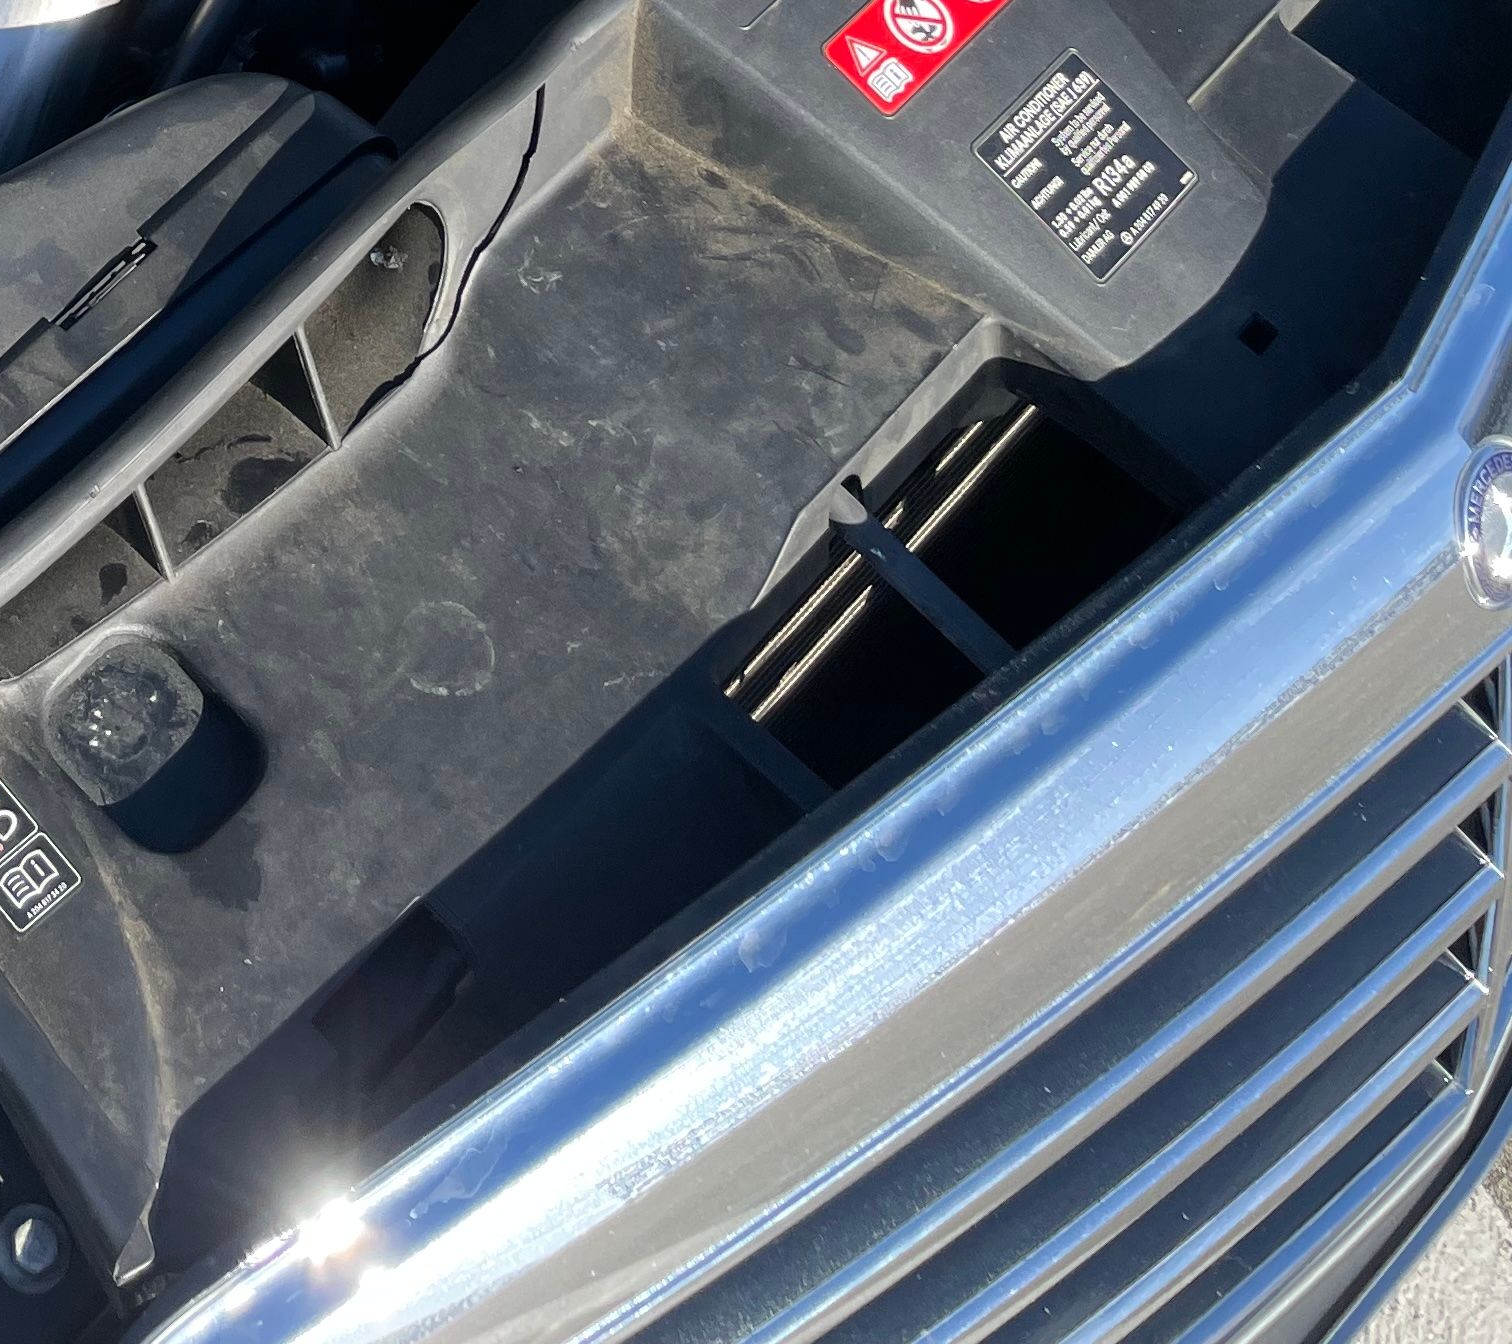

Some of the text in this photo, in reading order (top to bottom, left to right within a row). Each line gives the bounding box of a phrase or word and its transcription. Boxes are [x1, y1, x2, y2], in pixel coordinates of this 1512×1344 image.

[995, 109, 1055, 169] KLIMAANLAGE
[1049, 91, 1073, 116] (SAE
[1071, 70, 1095, 93] 639)
[999, 72, 1068, 143] AIR CONDITIONER
[1050, 124, 1074, 146] System
[1092, 155, 1135, 195] R134a
[1467, 451, 1512, 524] MERCEDE
